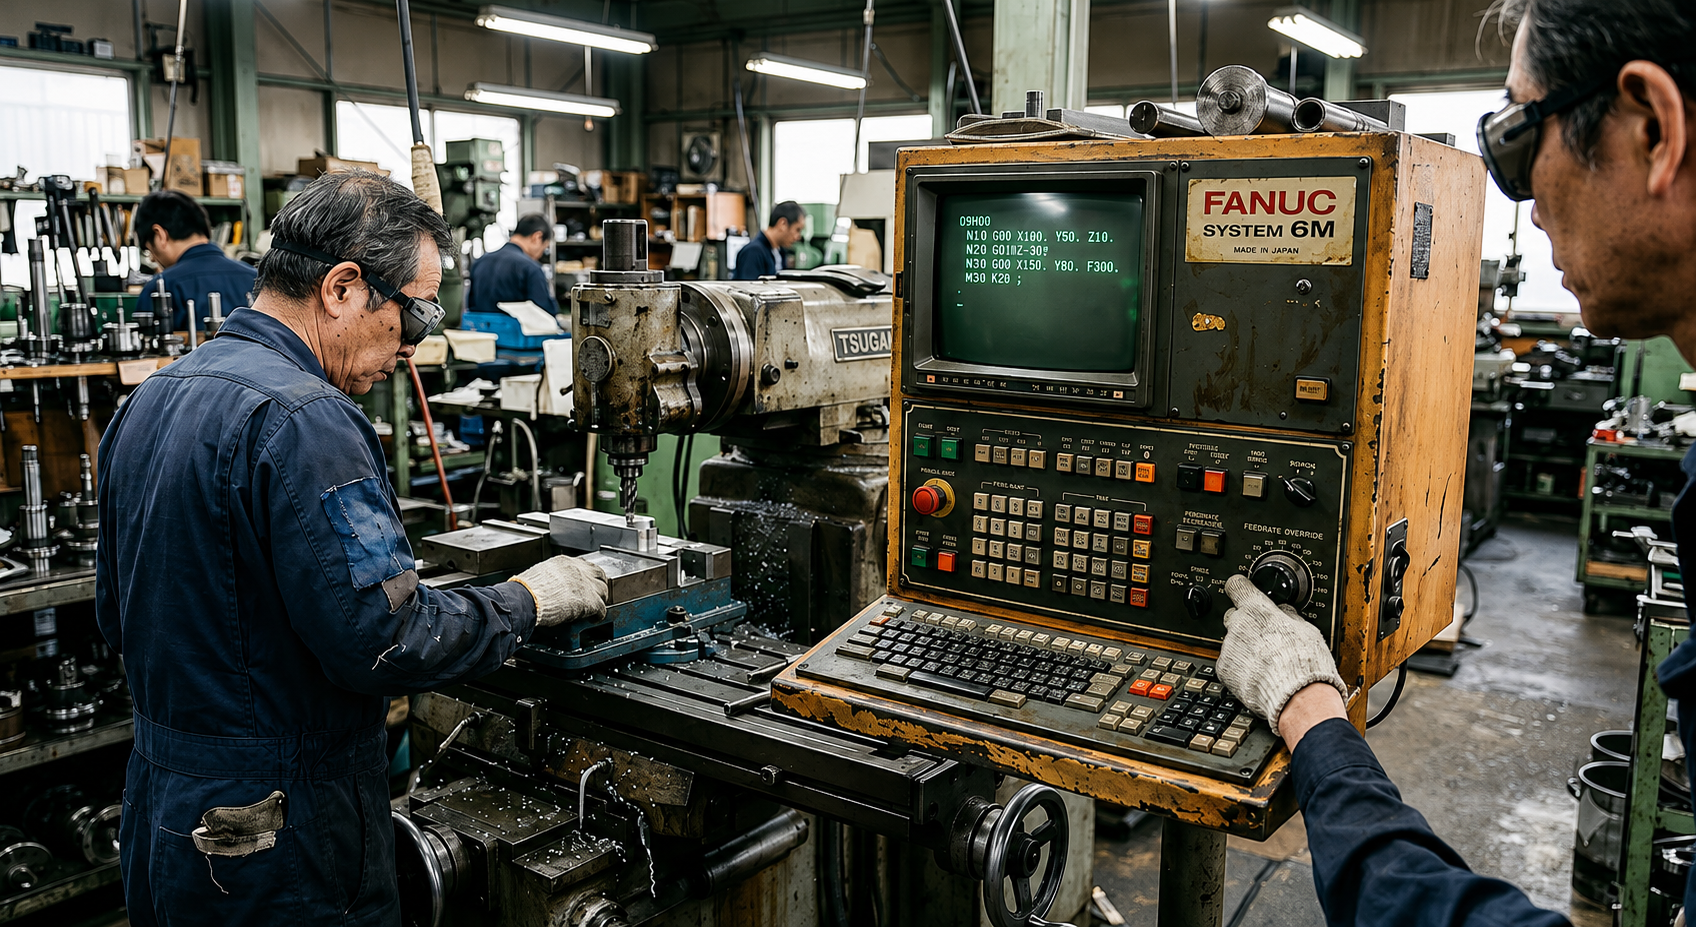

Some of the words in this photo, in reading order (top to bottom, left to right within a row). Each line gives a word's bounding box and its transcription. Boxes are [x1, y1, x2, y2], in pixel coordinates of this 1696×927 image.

[1204, 190, 1337, 215] FANUC
[966, 229, 987, 241] N10
[992, 230, 1012, 241] G00
[1055, 231, 1080, 242] Y50.
[1088, 231, 1114, 243] Z10.
[1203, 224, 1283, 238] SYSTEM
[1290, 220, 1335, 238] 6M
[966, 244, 987, 255] N20
[1233, 246, 1257, 254] MADE
[1271, 247, 1299, 255] JAPAN
[965, 258, 987, 269] N30
[992, 258, 1011, 270] G00
[1016, 259, 1047, 271] X150.
[1054, 260, 1079, 271] Y80.
[1087, 261, 1119, 273] F300.
[965, 272, 986, 283] M30
[991, 272, 1011, 284] K20
[1243, 522, 1282, 535] FEEDRATE
[1284, 528, 1324, 541] OVERRIDE
